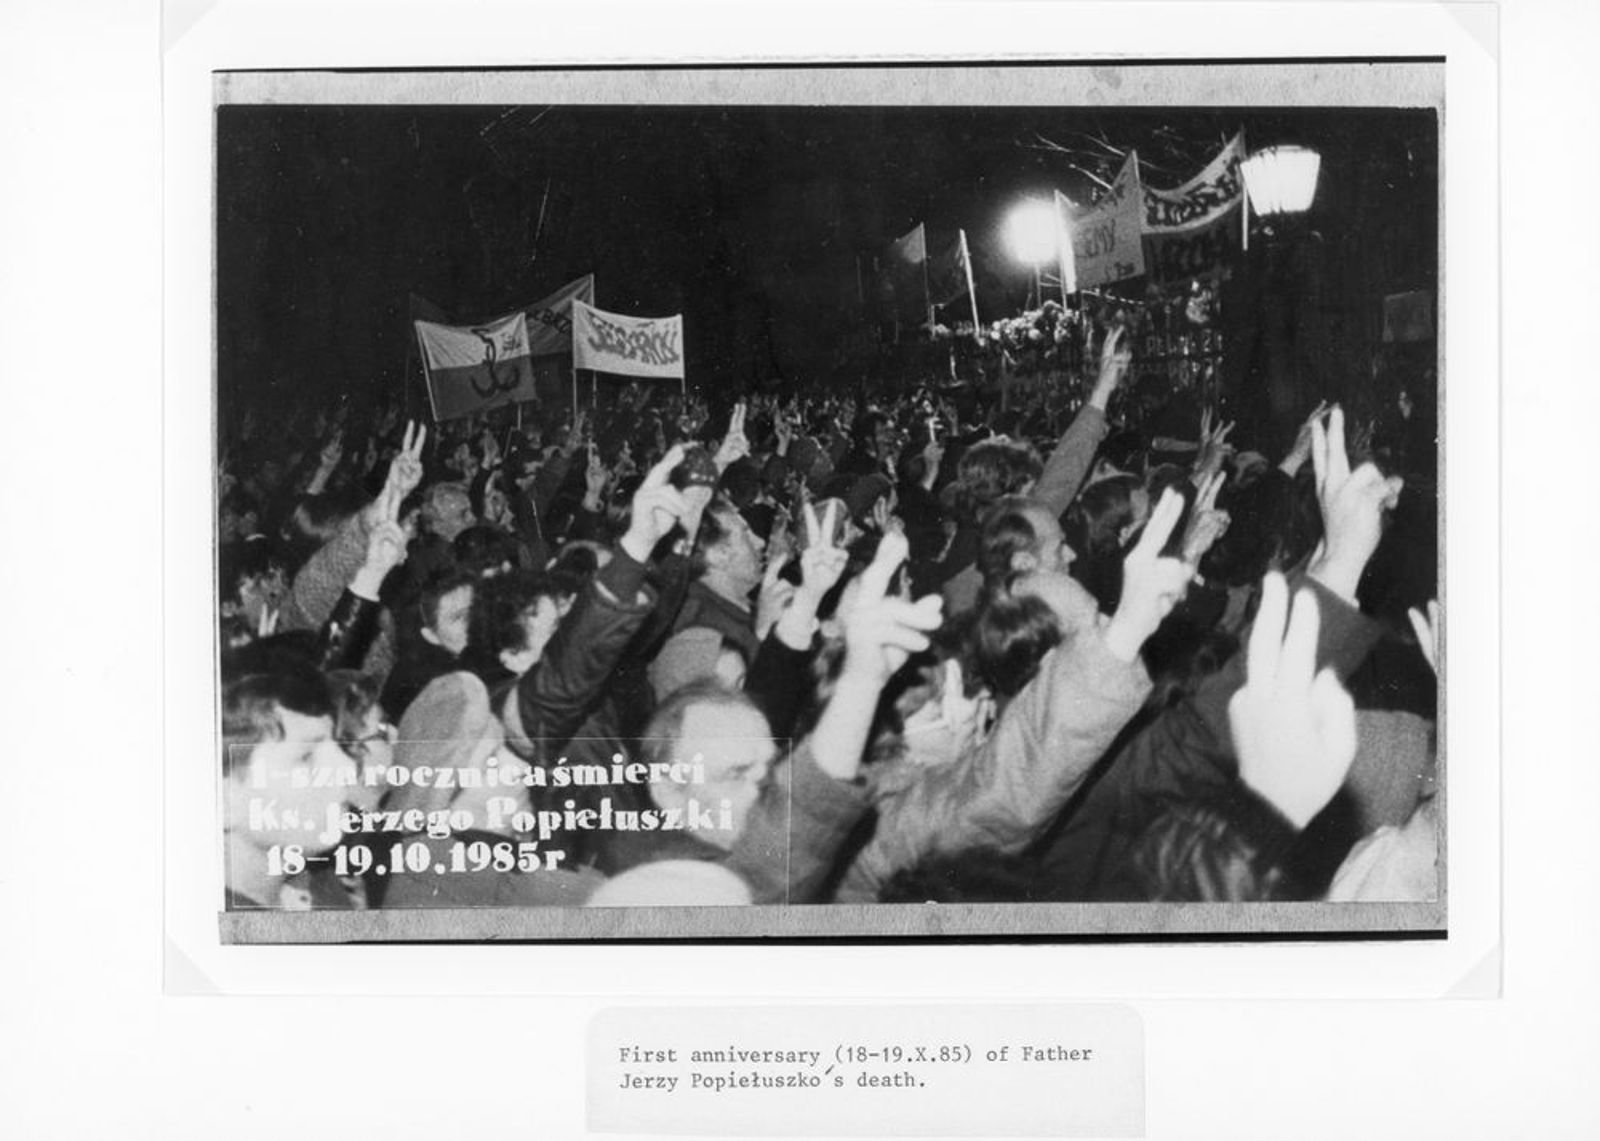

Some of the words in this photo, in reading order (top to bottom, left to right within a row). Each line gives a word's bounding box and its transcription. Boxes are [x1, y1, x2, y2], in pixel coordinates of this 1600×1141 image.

[619, 1046, 677, 1063] First
[690, 1045, 821, 1068] anniversary
[835, 1044, 972, 1063] (18-19.X.85)
[986, 1045, 1009, 1062] of
[1022, 1045, 1093, 1062] Father
[619, 1073, 679, 1093] Jerzy
[856, 1071, 926, 1088] death.
